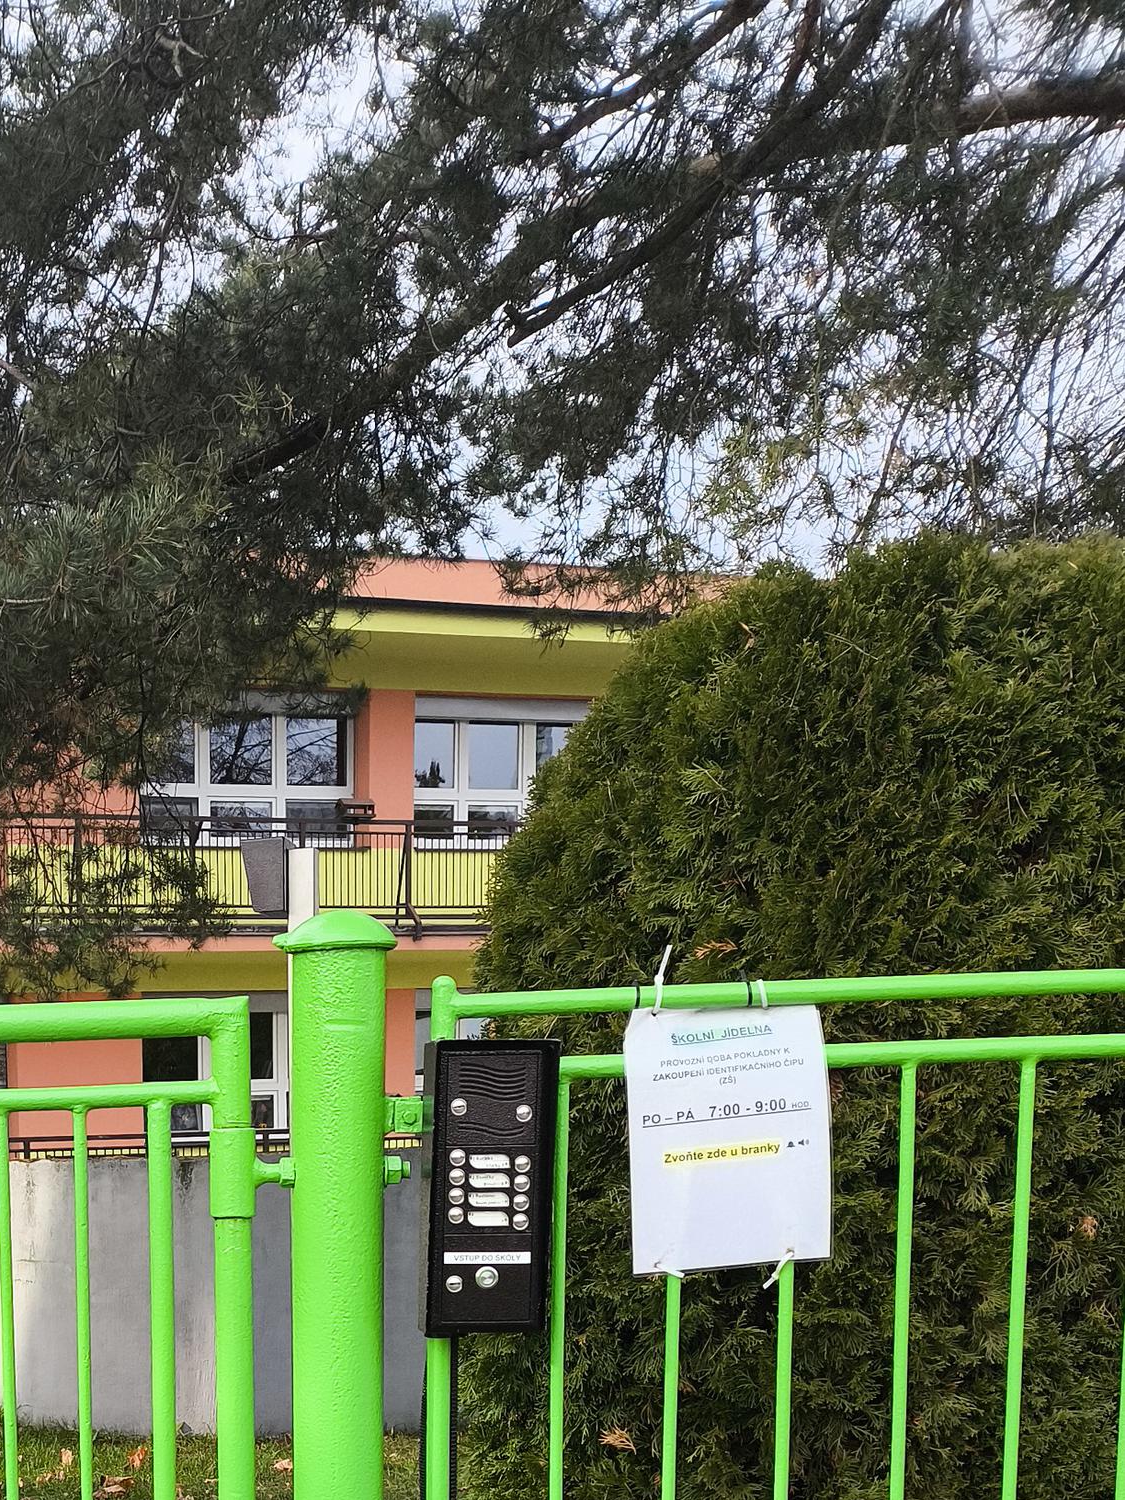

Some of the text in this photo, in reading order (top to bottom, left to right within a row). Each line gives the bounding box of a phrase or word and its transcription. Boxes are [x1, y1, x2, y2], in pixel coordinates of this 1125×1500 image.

[670, 1024, 772, 1044] ŠKOLNÍ JÍDELNA
[660, 1056, 704, 1068] PROVOZNÍ
[707, 1055, 732, 1064] DOBA
[734, 1048, 781, 1060] POKLADNY
[652, 1068, 704, 1082] ZAKOUPENÍ
[707, 1060, 782, 1075] IDENTIFIKAČNÍHO
[719, 1076, 737, 1086] (ZŠ)
[642, 1114, 661, 1125] PO
[676, 1108, 695, 1121] PÁ
[708, 1103, 740, 1118] 7:00
[755, 1098, 787, 1113] 9:00
[664, 1151, 704, 1164] Zvoňte
[707, 1148, 727, 1159] zde
[741, 1143, 781, 1155] branky
